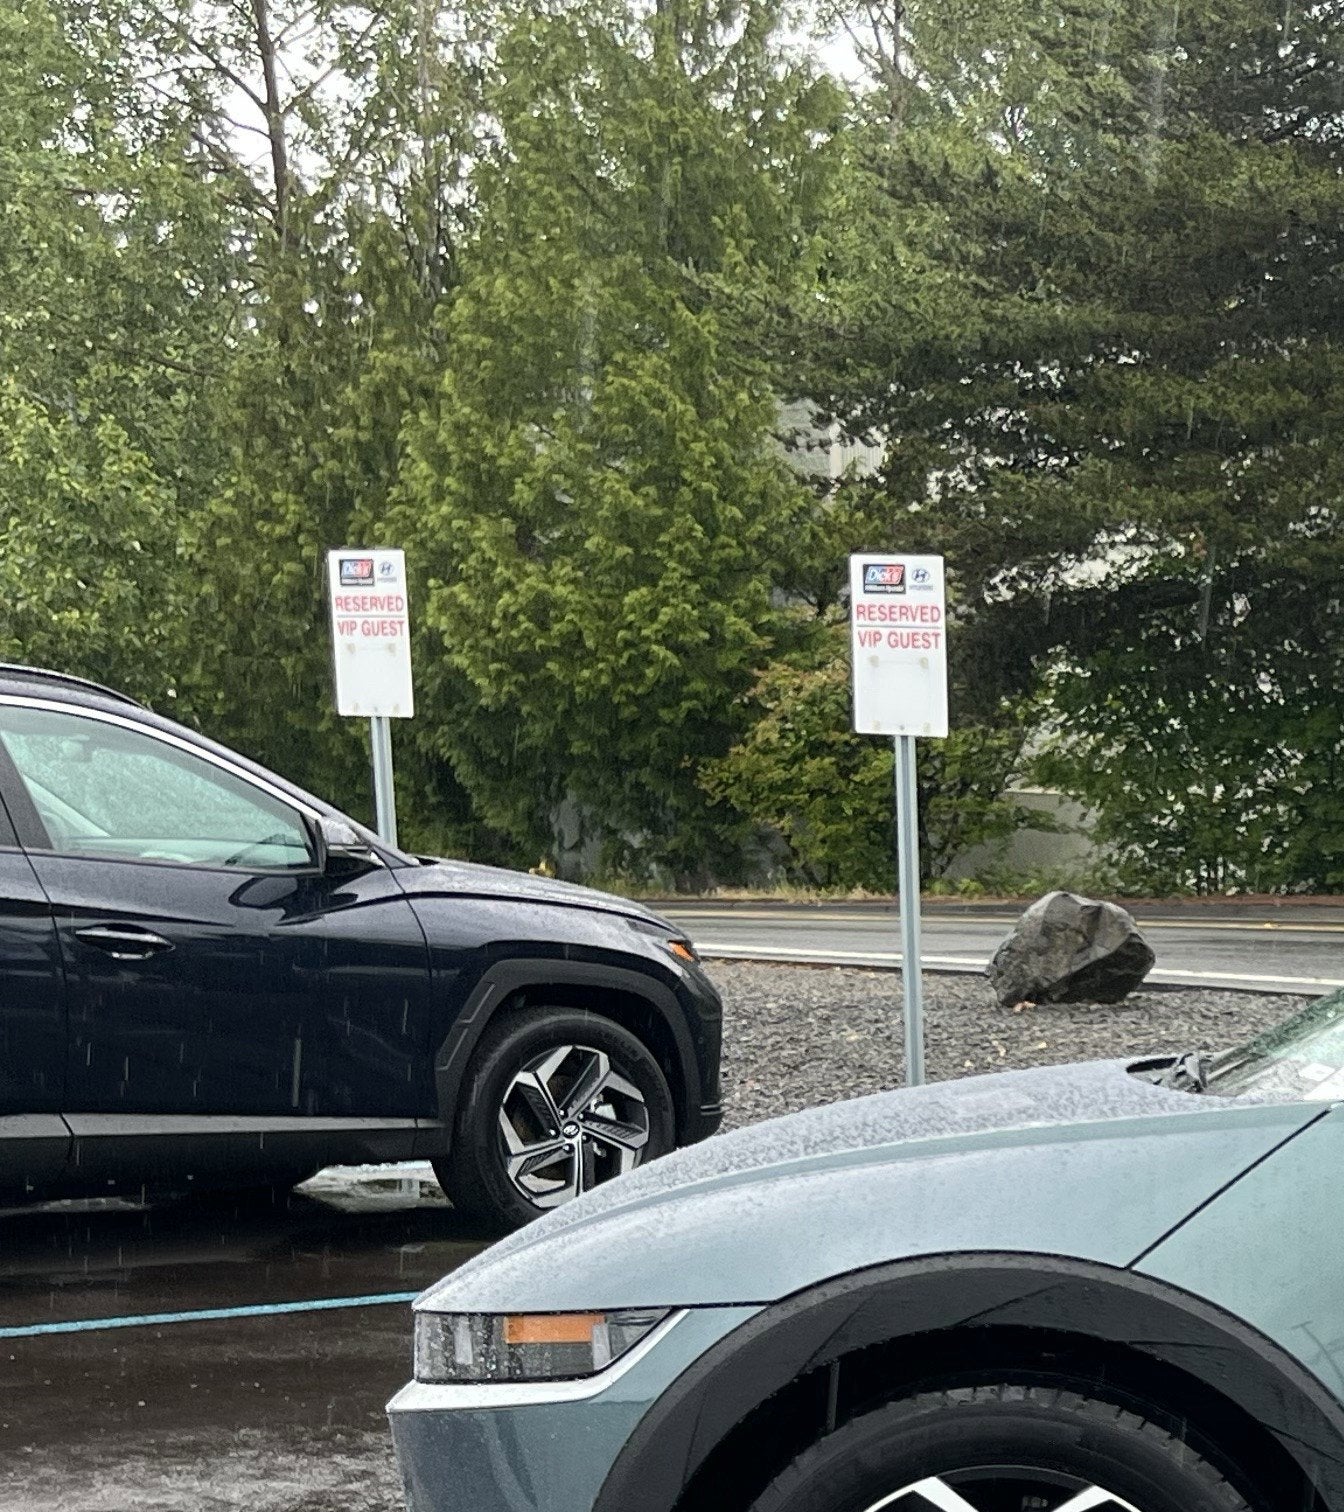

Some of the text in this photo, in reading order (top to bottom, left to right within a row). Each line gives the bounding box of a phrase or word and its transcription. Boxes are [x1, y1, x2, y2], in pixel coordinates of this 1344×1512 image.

[335, 595, 404, 612] RESERVED
[856, 604, 941, 623] RESERVED
[337, 620, 405, 636] VIP GUEST
[858, 631, 941, 650] VIP GUEST
